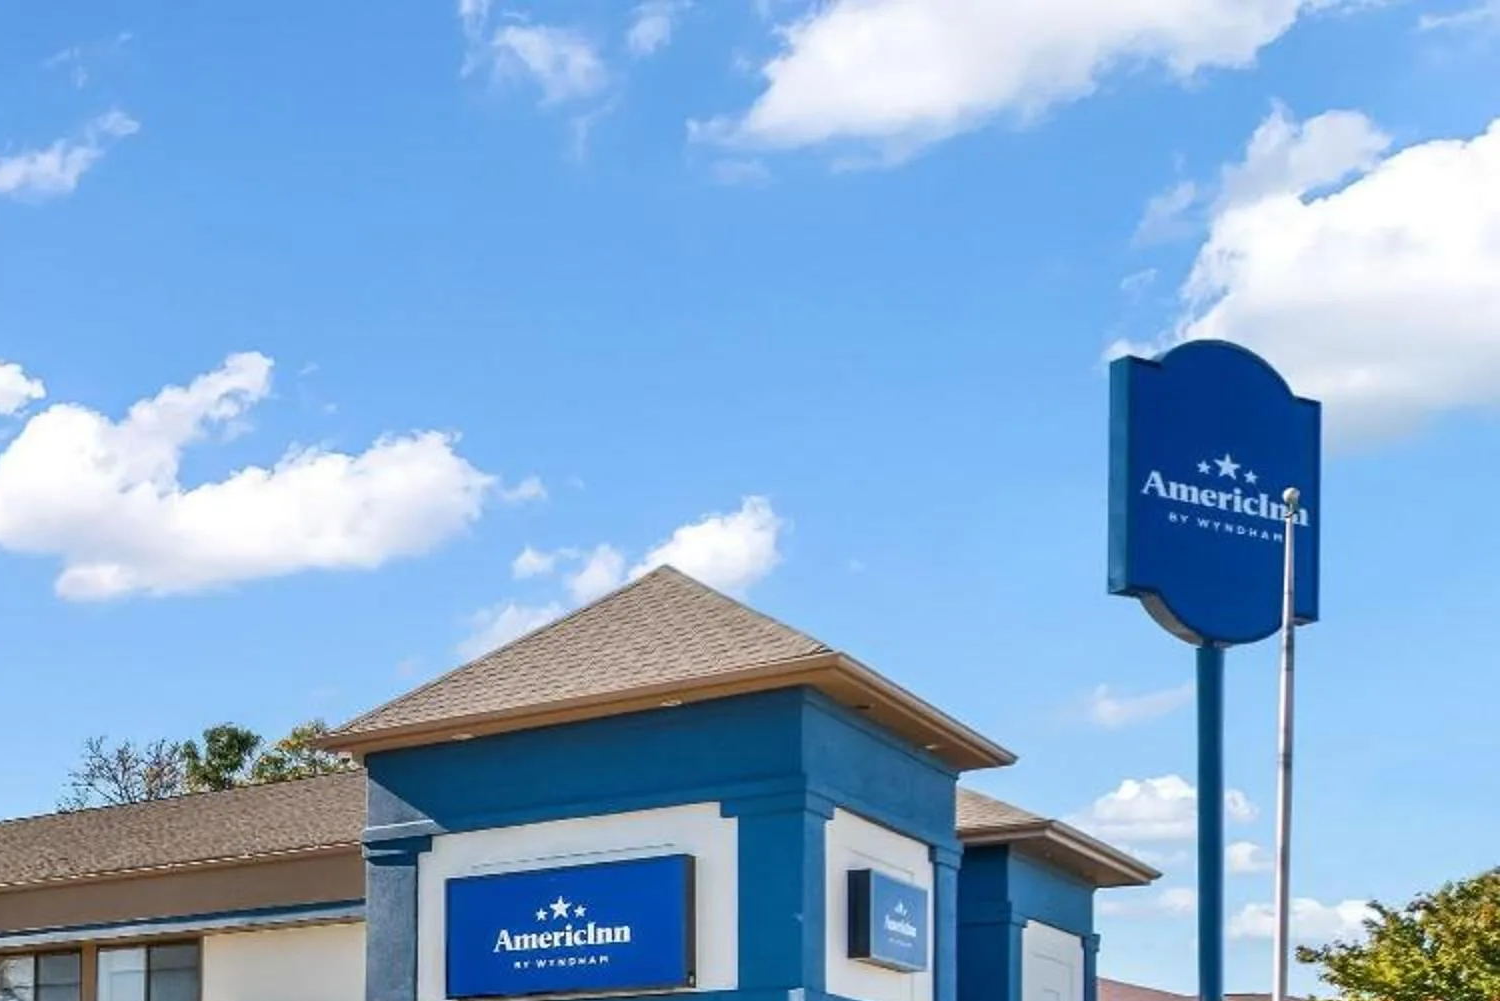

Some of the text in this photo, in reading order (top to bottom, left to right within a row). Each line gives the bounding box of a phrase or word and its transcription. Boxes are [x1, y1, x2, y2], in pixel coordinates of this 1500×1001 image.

[1168, 511, 1283, 543] BY WYNDHAM
[493, 921, 631, 953] AmericInn
